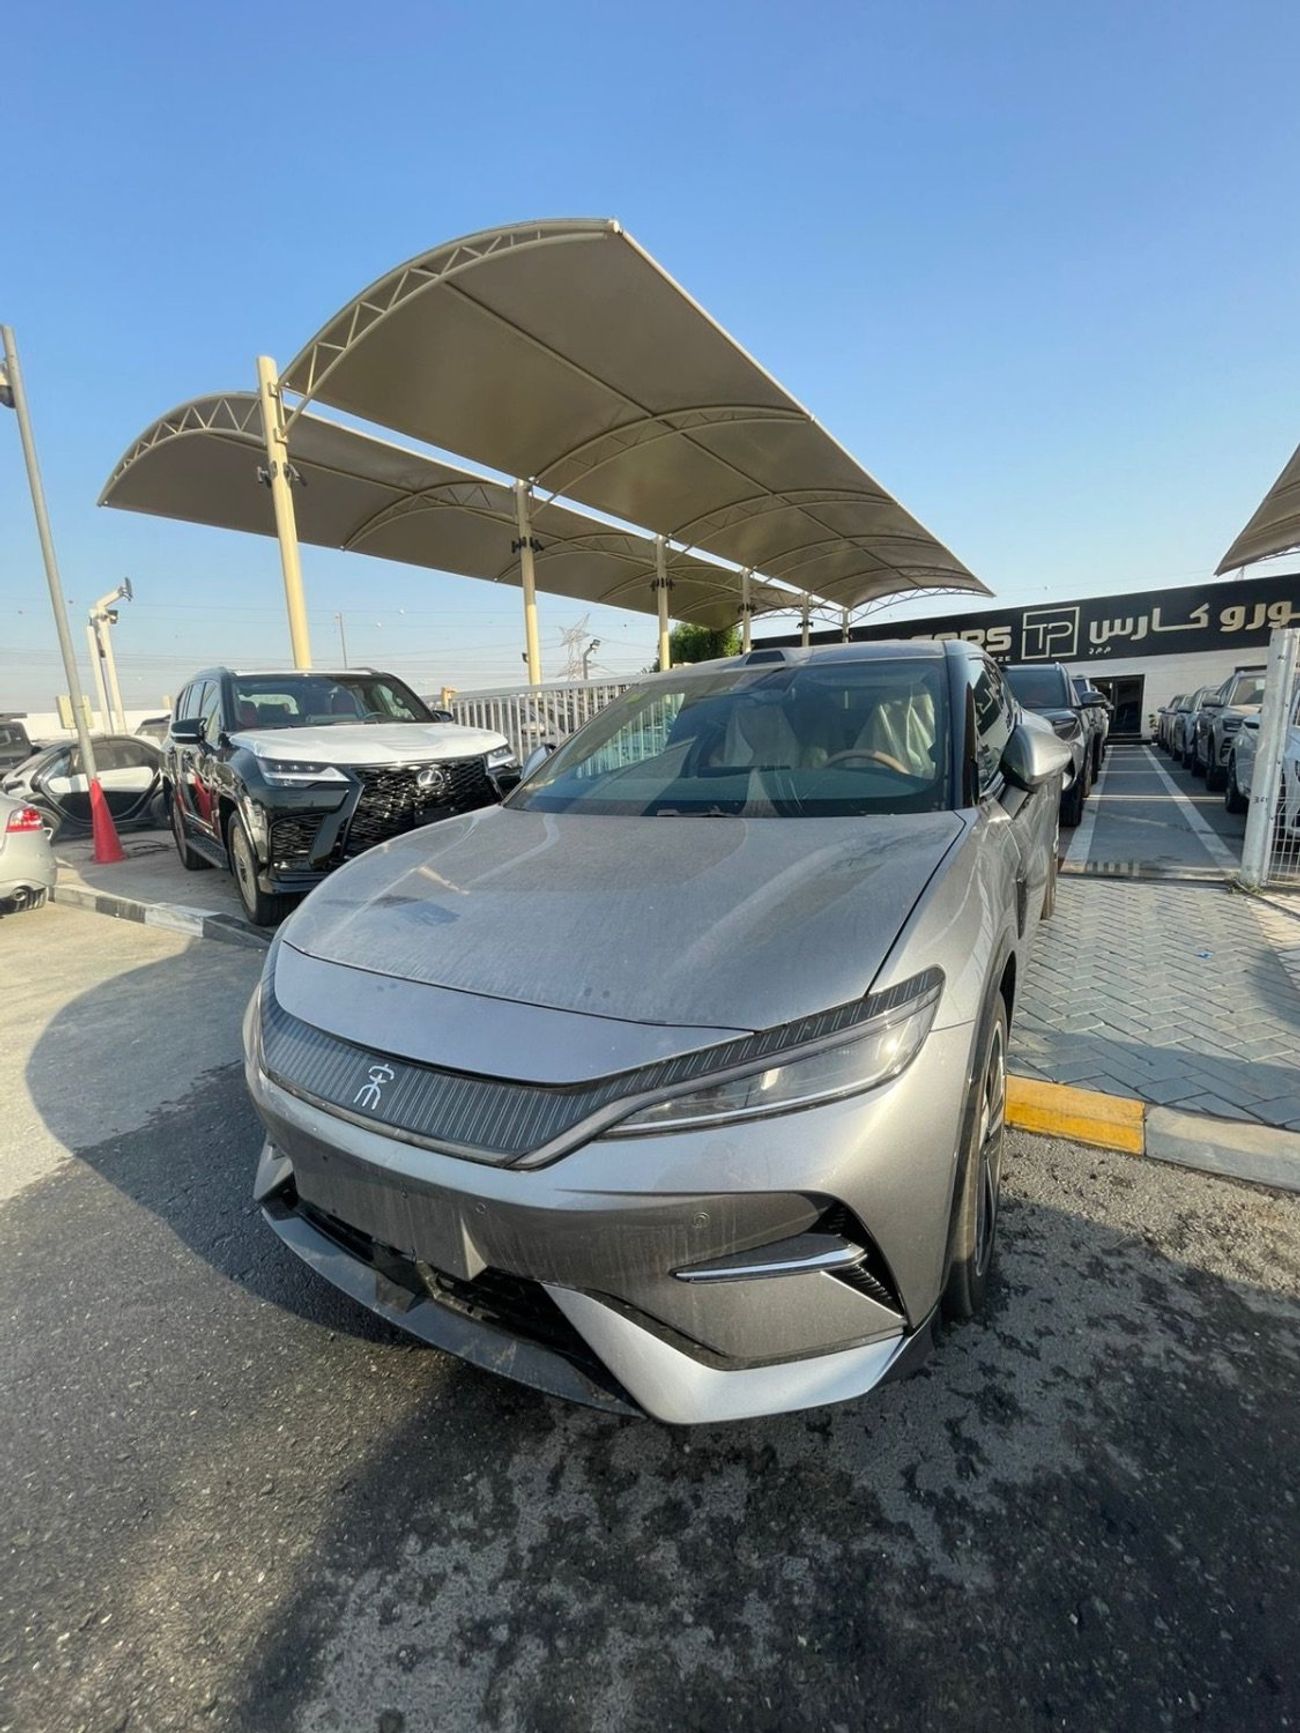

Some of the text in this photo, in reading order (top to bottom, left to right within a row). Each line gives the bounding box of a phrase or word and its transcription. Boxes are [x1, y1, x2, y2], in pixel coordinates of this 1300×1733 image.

[910, 625, 1012, 653] RS
[1089, 601, 1300, 645] ورو كارس
